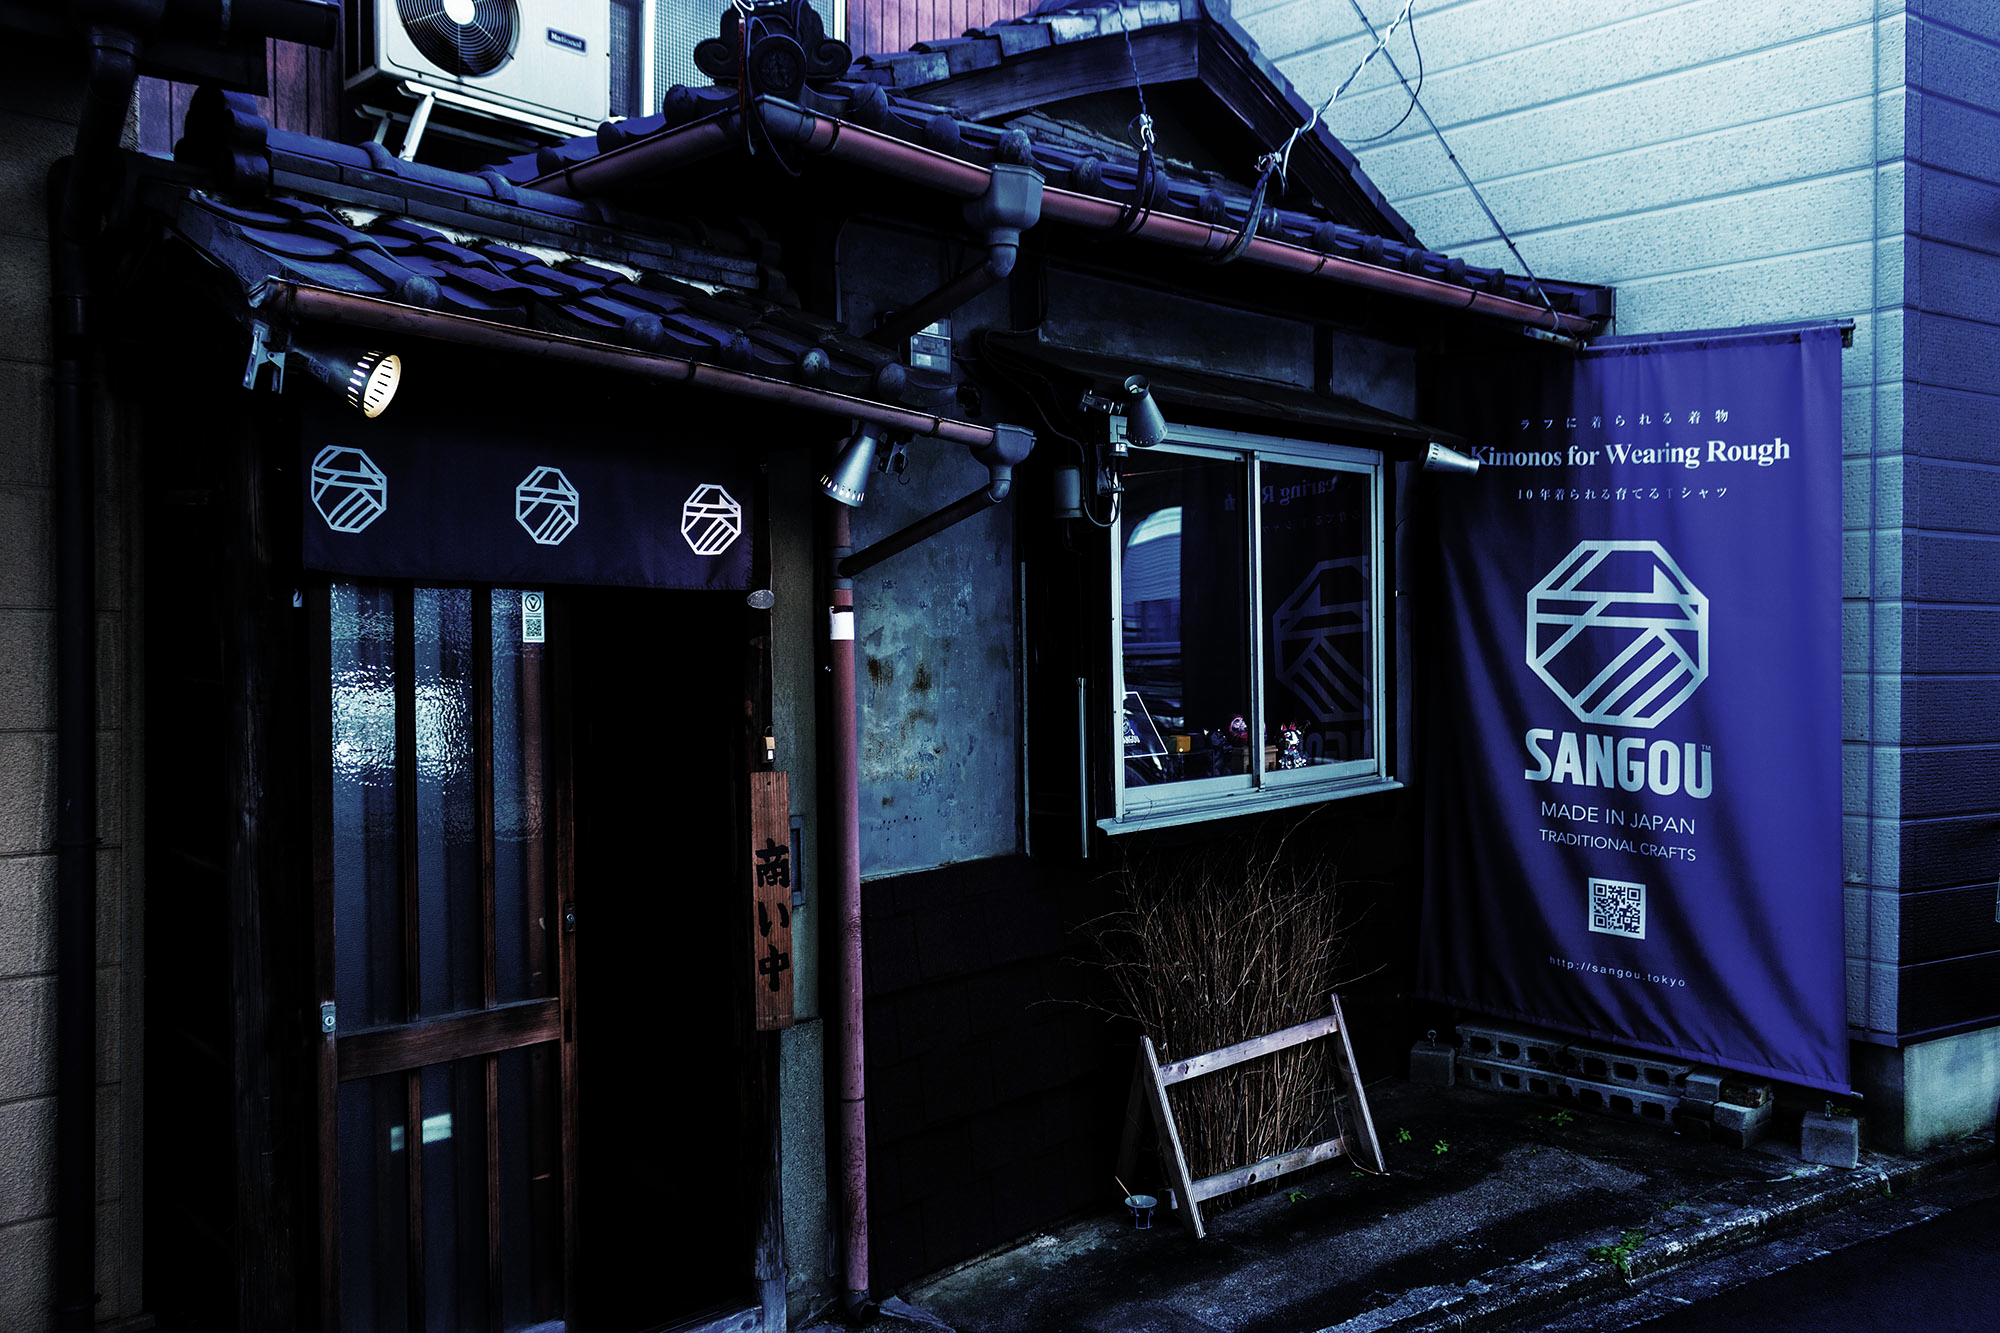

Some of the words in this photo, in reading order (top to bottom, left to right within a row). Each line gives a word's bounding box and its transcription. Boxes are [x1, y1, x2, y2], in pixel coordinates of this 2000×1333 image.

[1519, 409, 1731, 431] ラフに着られる着物
[1470, 445, 1563, 468] Kimonos
[1567, 444, 1600, 467] for
[1604, 441, 1701, 470] Wearing
[1706, 437, 1791, 468] Rough
[1524, 728, 1713, 799] SANGOU
[1541, 801, 1599, 824] MADE
[1605, 808, 1625, 826] IN
[1629, 812, 1696, 836] JAPAN
[1539, 828, 1637, 854] TRADITIONAL
[1640, 842, 1697, 862] CRAFTS
[755, 837, 791, 993] 商い中
[1549, 955, 1687, 989] http://sangou.tokyo
